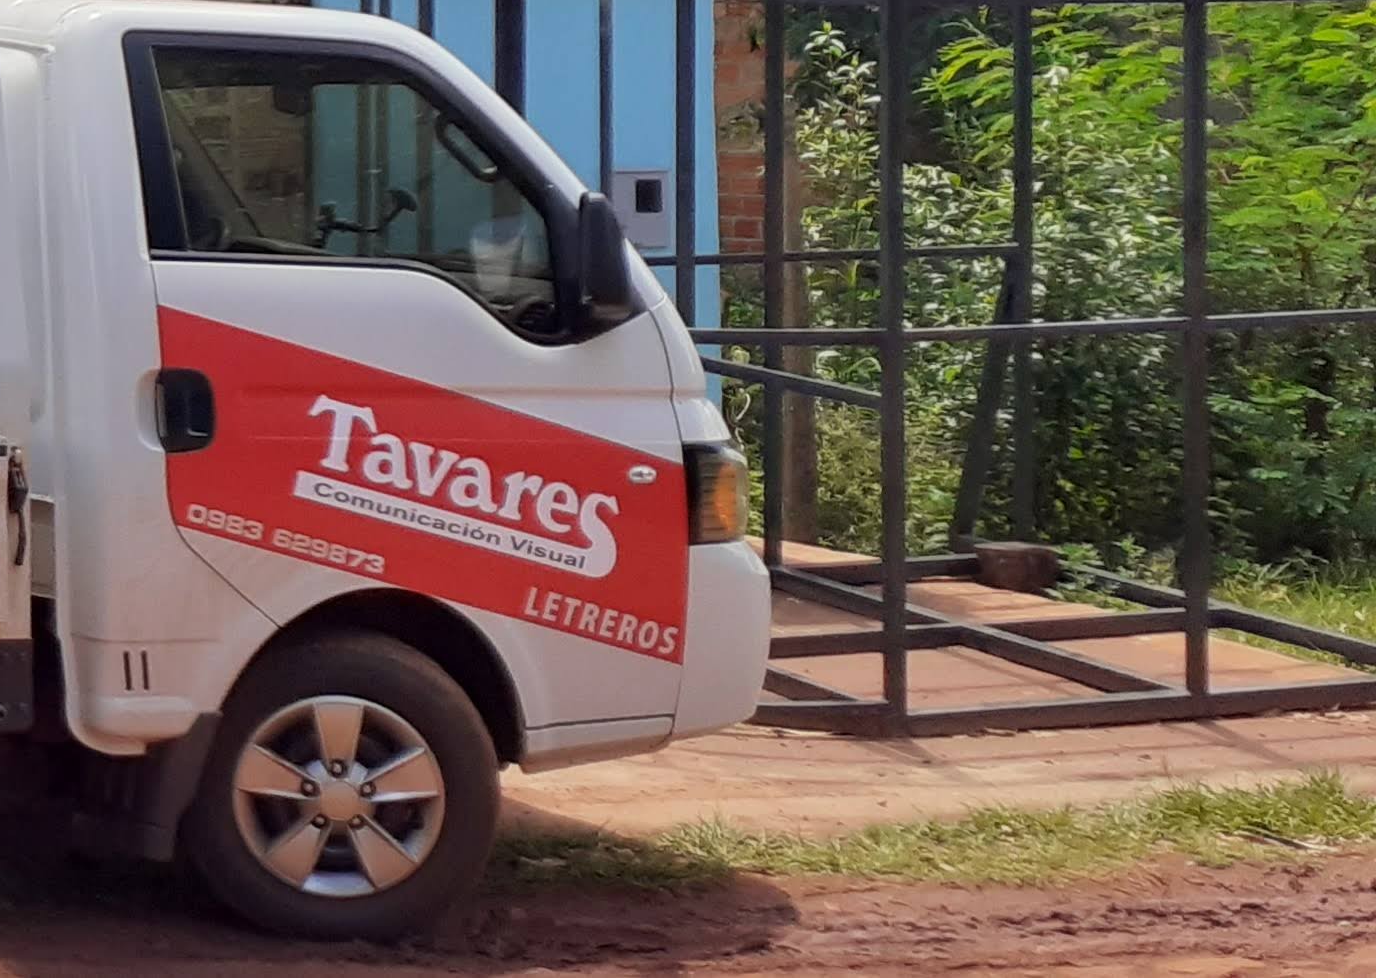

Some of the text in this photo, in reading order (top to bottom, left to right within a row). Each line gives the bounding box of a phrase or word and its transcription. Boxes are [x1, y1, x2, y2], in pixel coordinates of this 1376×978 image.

[309, 395, 621, 578] Tavares
[187, 503, 385, 575] 0983 629873
[314, 483, 586, 570] Comunicación Visual
[524, 585, 679, 656] LETREROS
